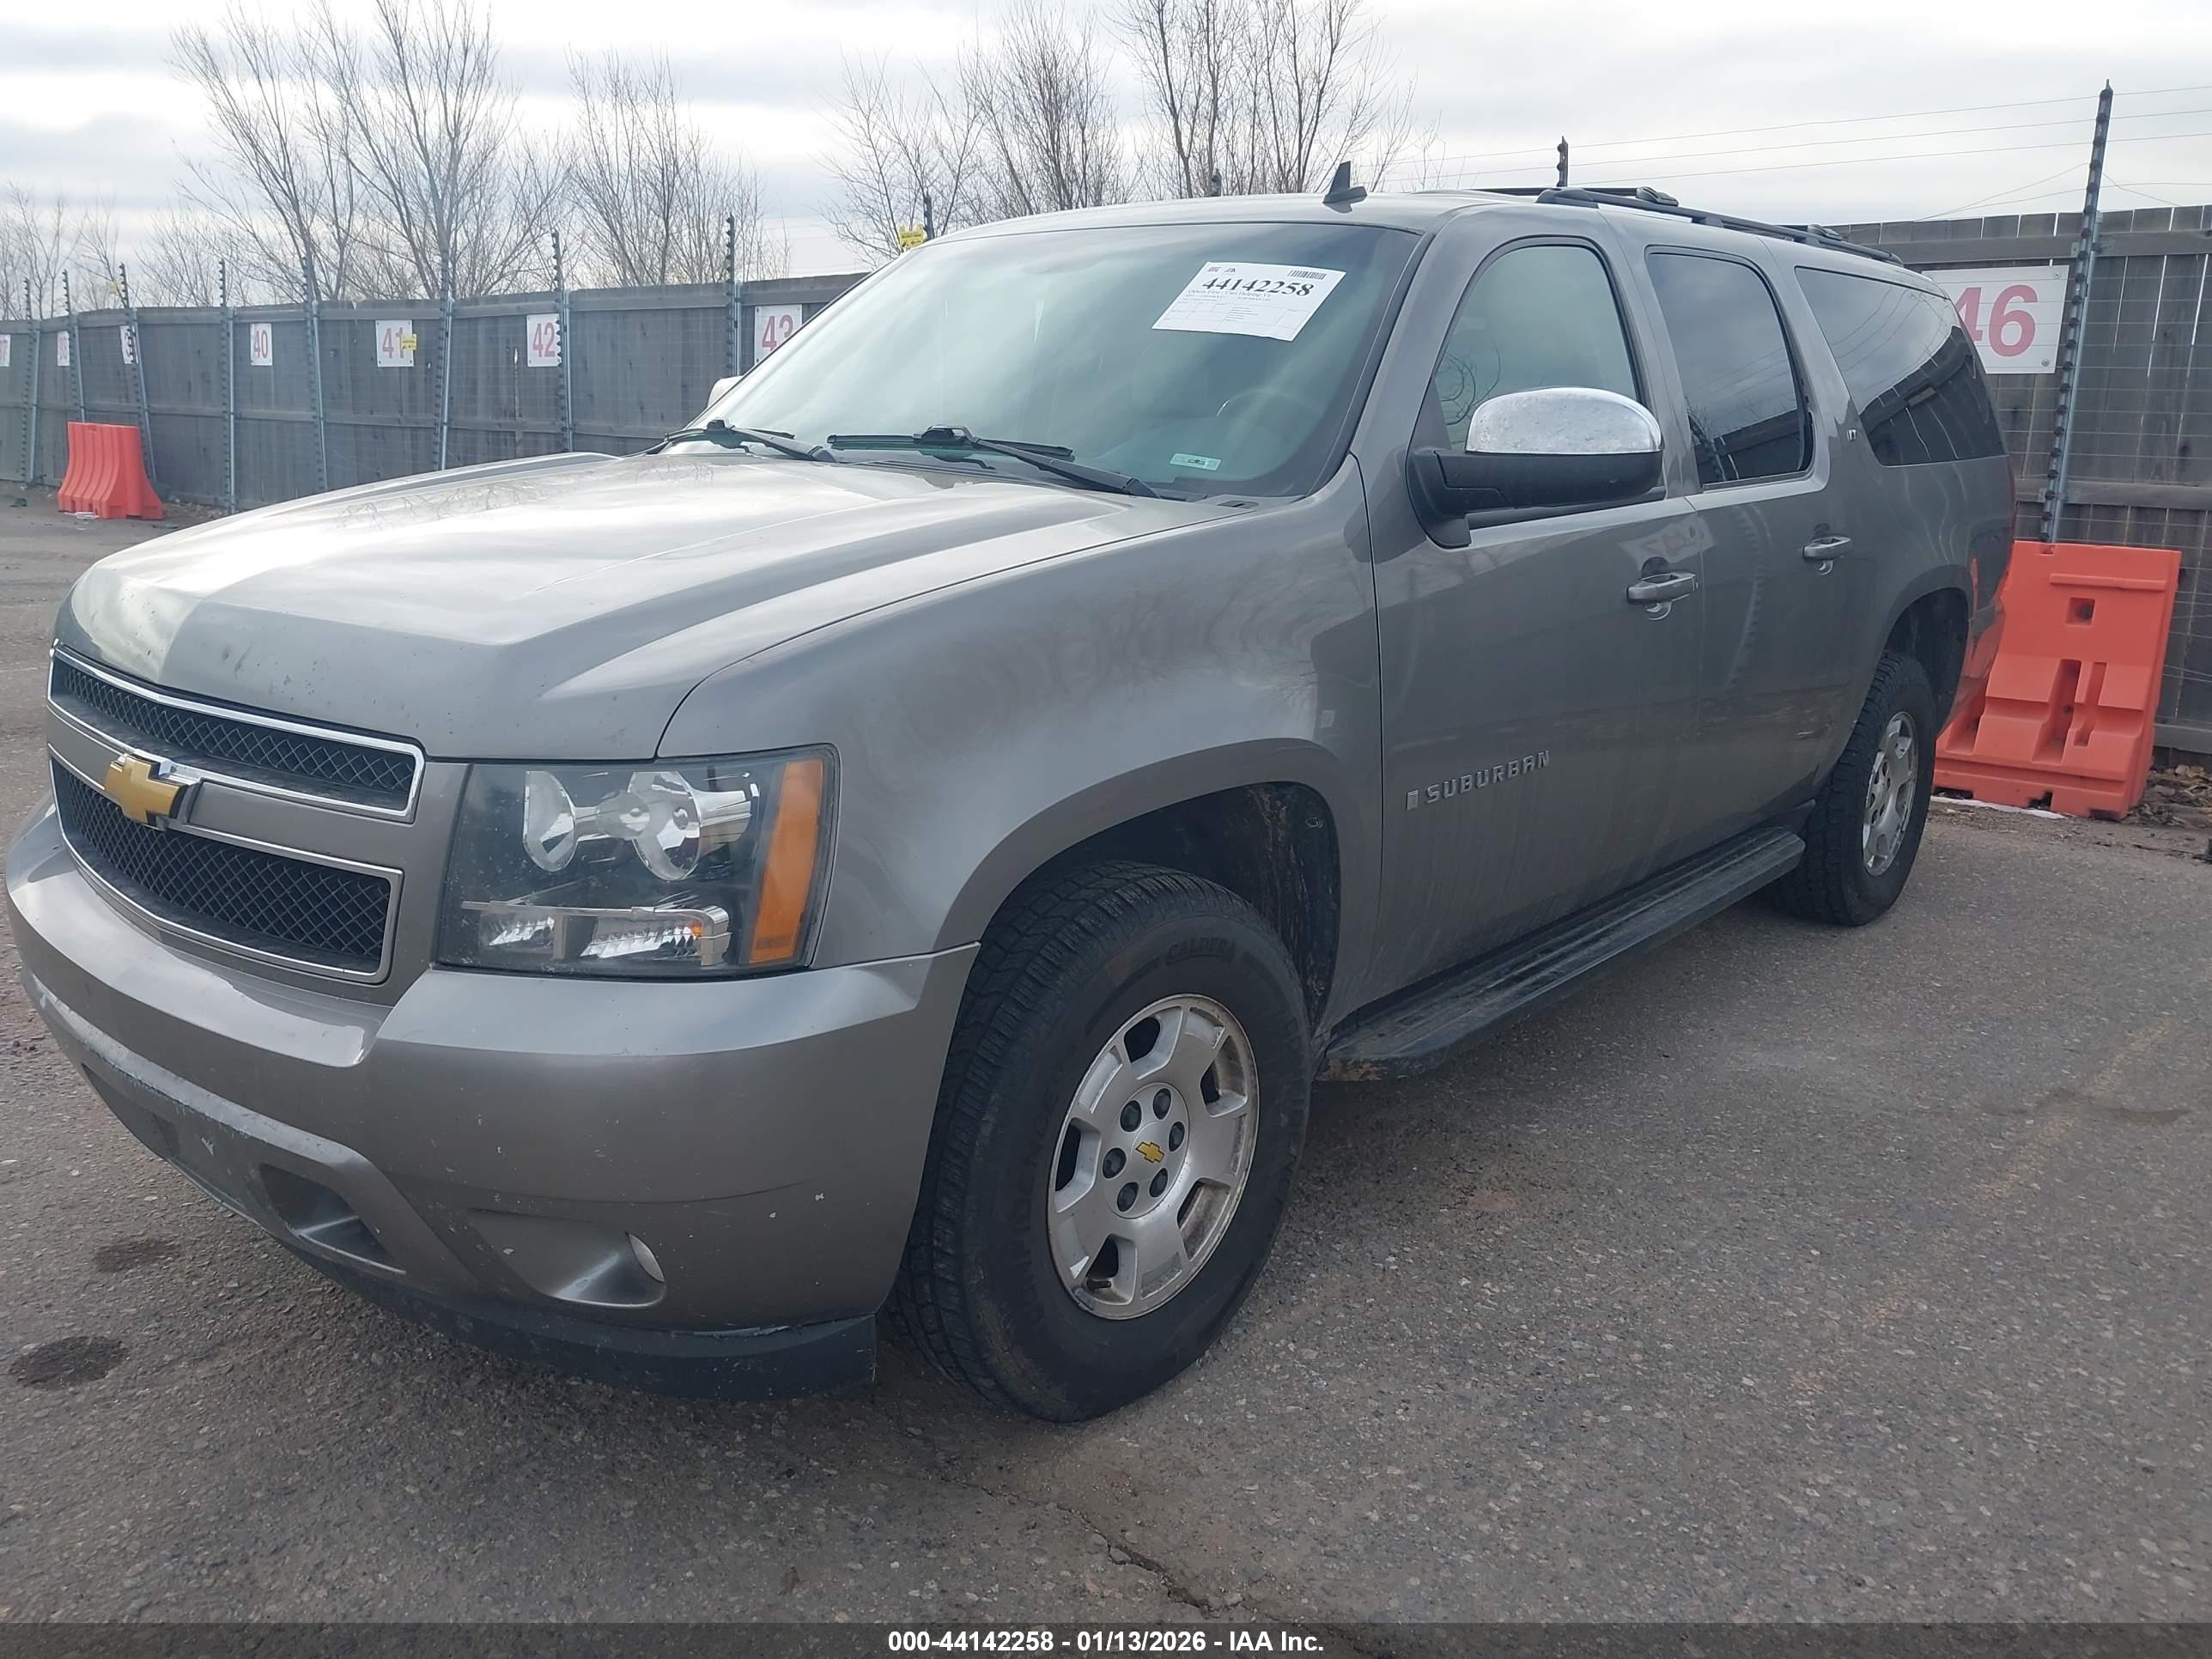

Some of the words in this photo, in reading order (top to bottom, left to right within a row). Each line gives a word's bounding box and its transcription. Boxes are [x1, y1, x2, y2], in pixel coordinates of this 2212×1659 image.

[1202, 277, 1315, 296] 44142258
[1954, 284, 2039, 357] 46
[253, 330, 269, 359] 40
[382, 326, 404, 359] 41
[532, 322, 556, 358] 42
[1425, 750, 1551, 804] SUBURBAN
